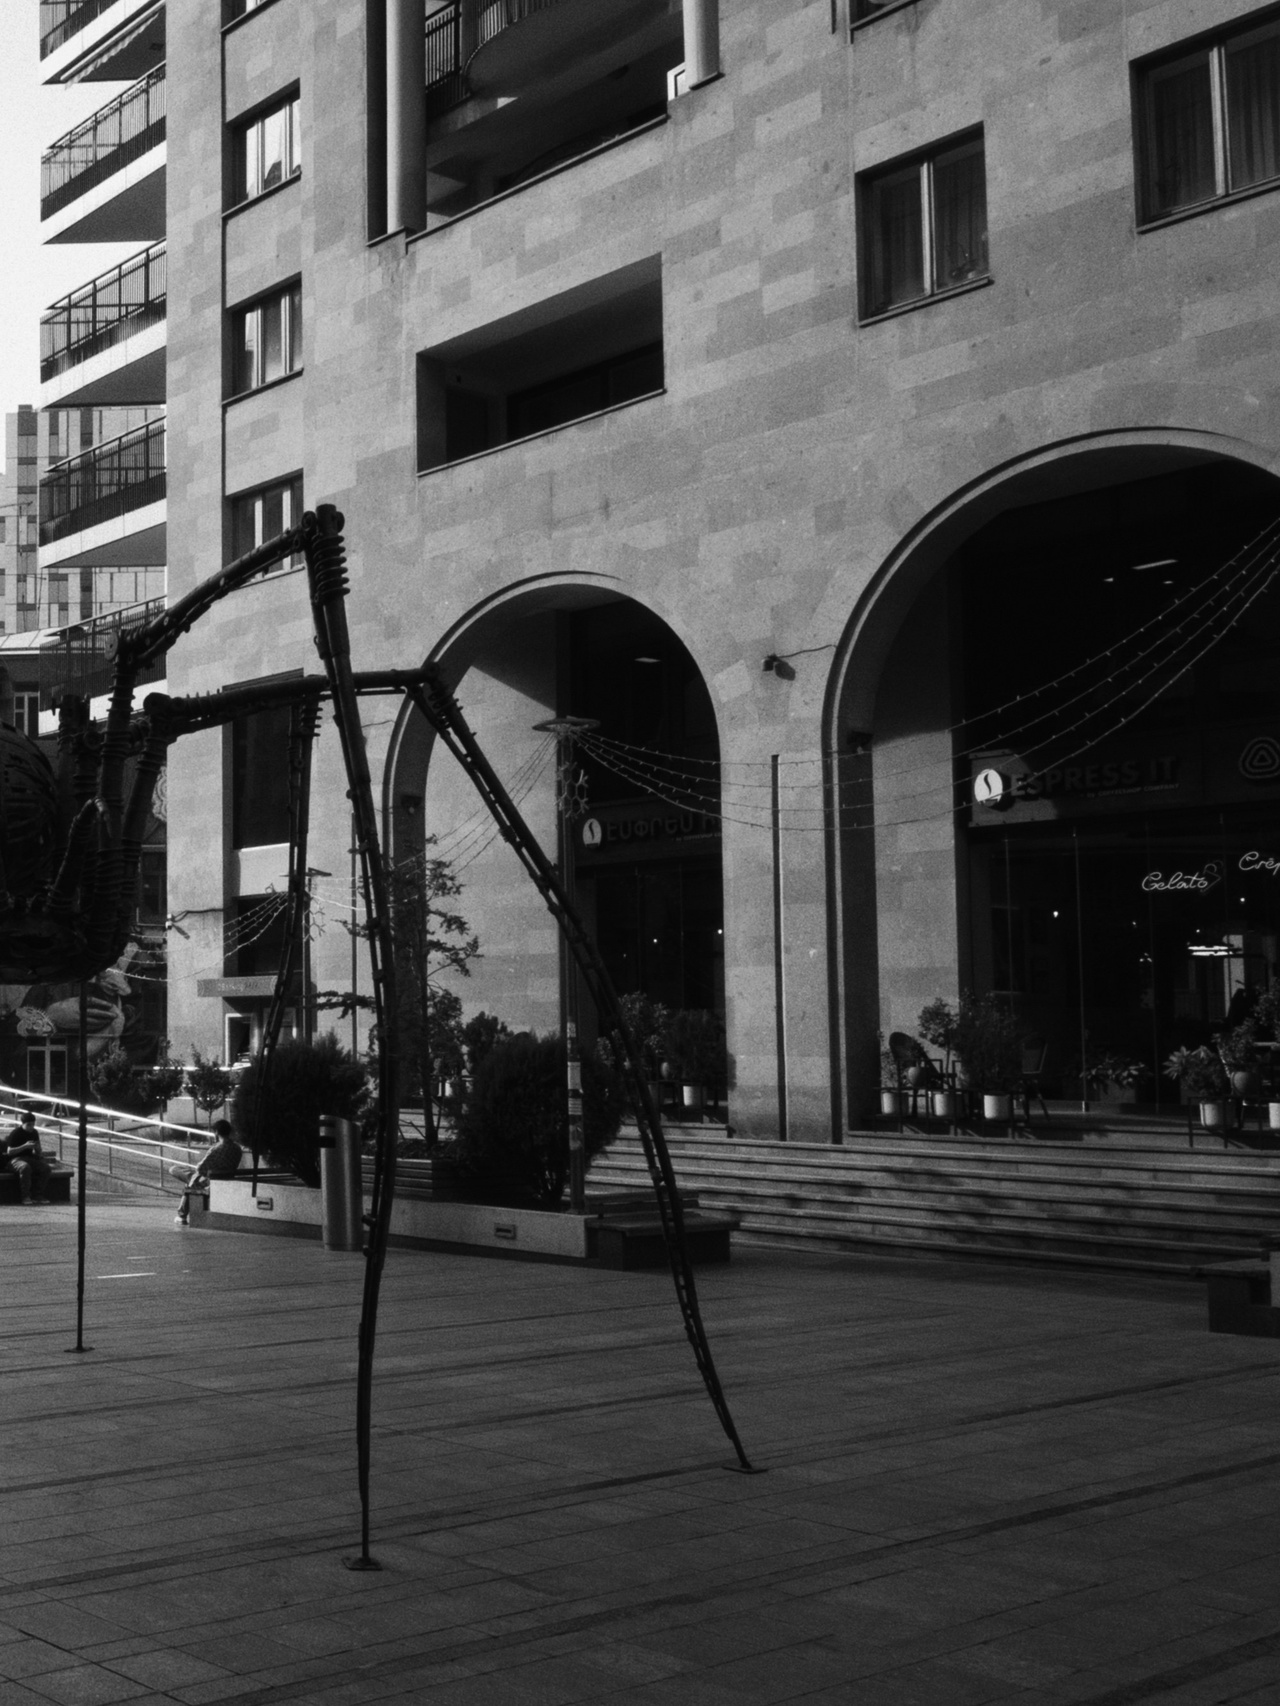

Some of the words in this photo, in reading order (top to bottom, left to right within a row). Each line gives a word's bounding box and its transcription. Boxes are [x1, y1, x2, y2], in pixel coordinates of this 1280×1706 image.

[1011, 760, 1139, 796] ESPRESS
[1149, 756, 1177, 781] IT
[1141, 871, 1209, 891] Gelato
